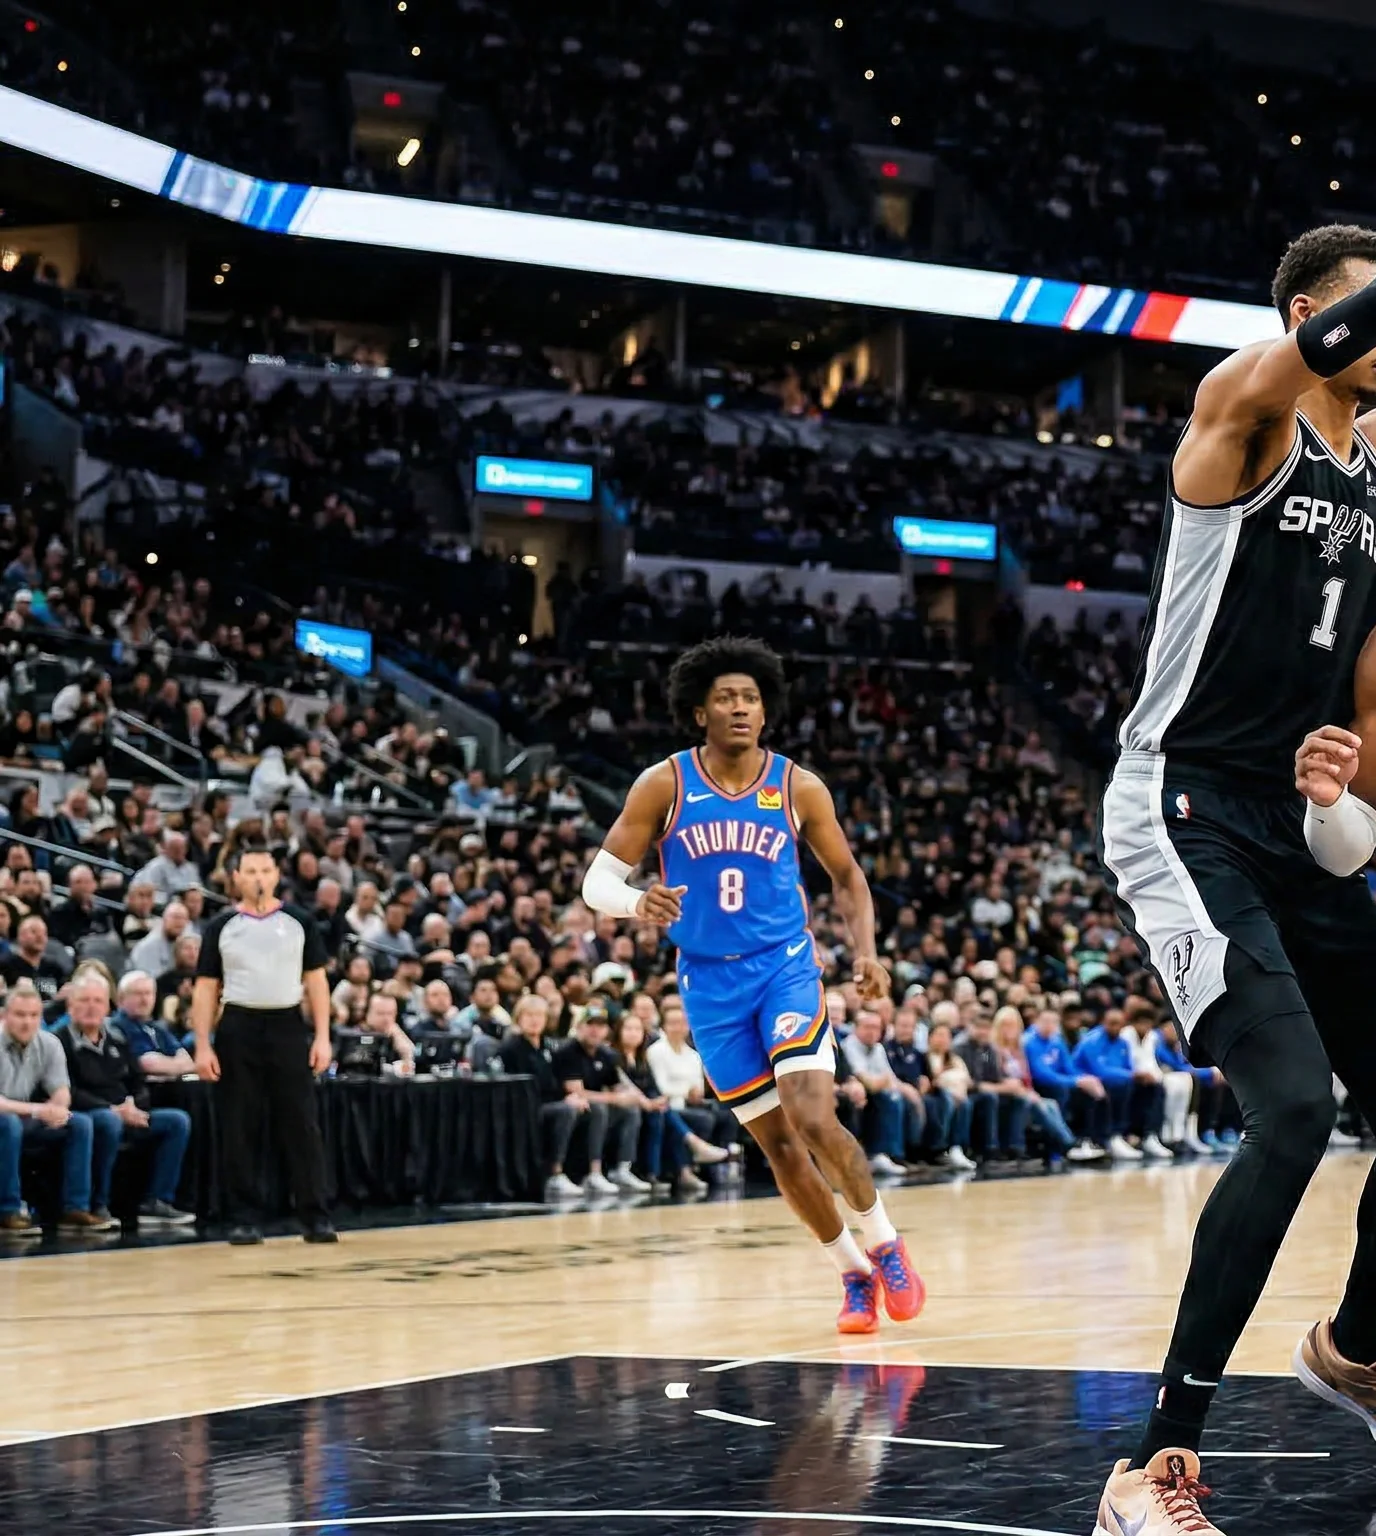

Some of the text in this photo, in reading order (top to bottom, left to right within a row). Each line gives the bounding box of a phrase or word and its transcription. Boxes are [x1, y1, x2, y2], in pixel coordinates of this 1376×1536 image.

[1309, 576, 1346, 652] 1
[676, 820, 788, 863] THUNDER
[718, 866, 745, 913] 8
